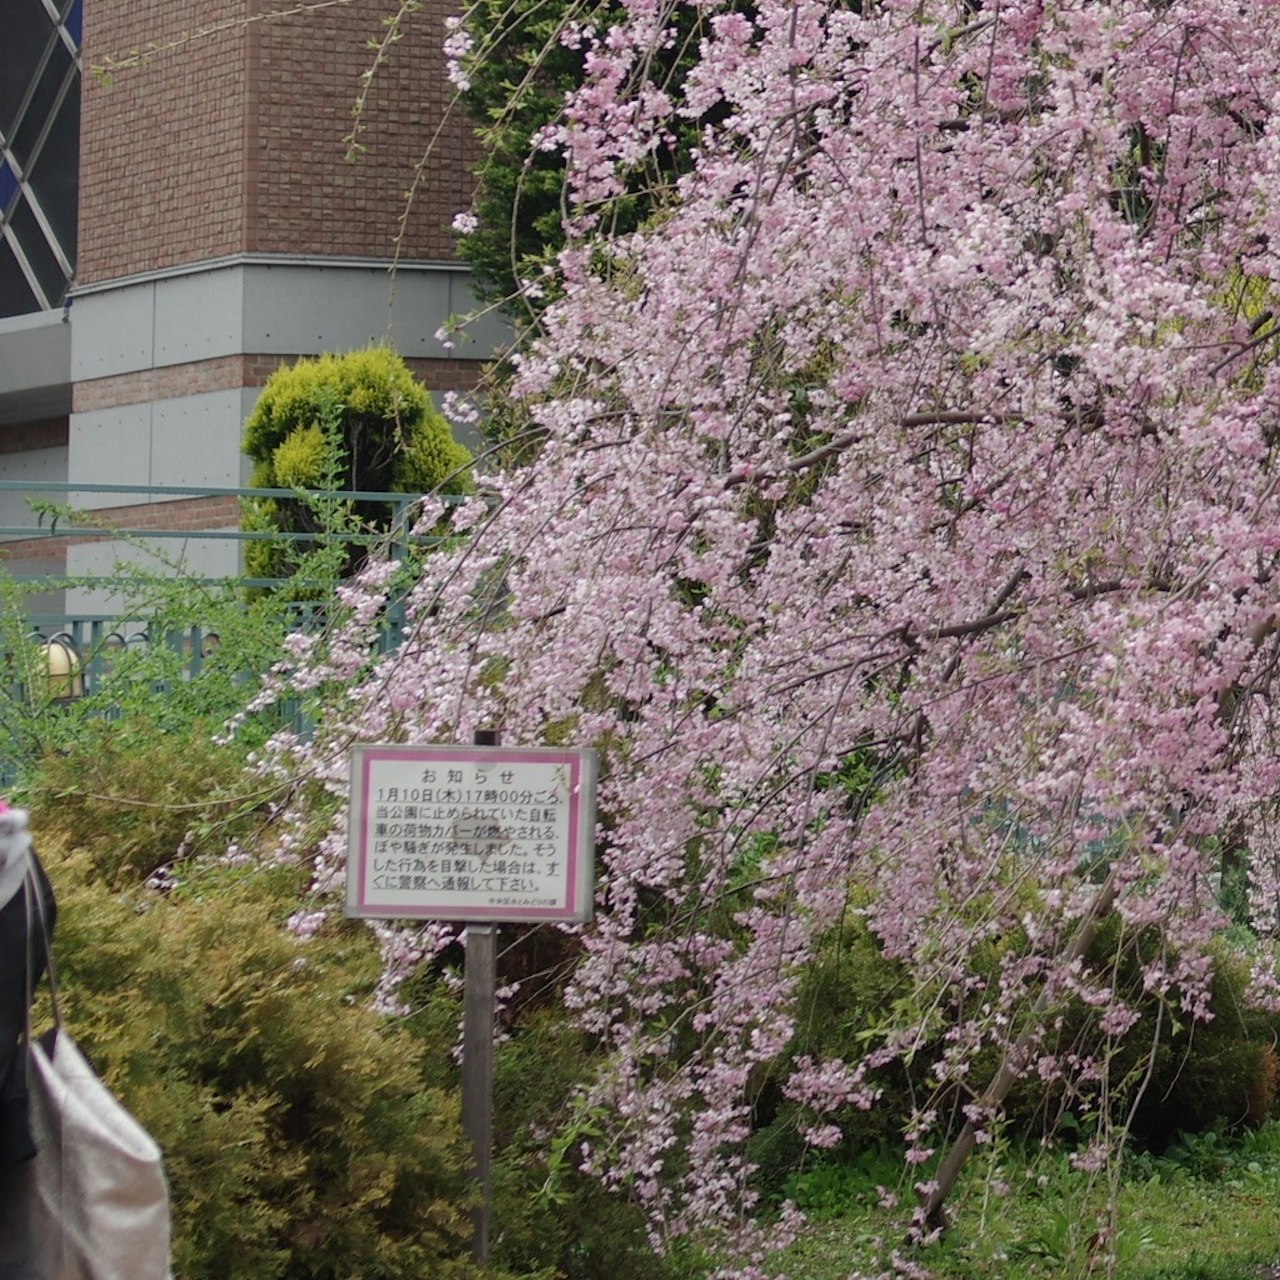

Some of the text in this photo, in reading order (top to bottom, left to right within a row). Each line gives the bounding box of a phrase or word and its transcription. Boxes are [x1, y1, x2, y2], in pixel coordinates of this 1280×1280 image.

[421, 768, 515, 784] お知らせ
[375, 805, 558, 823] 当公園に止められていた自転
